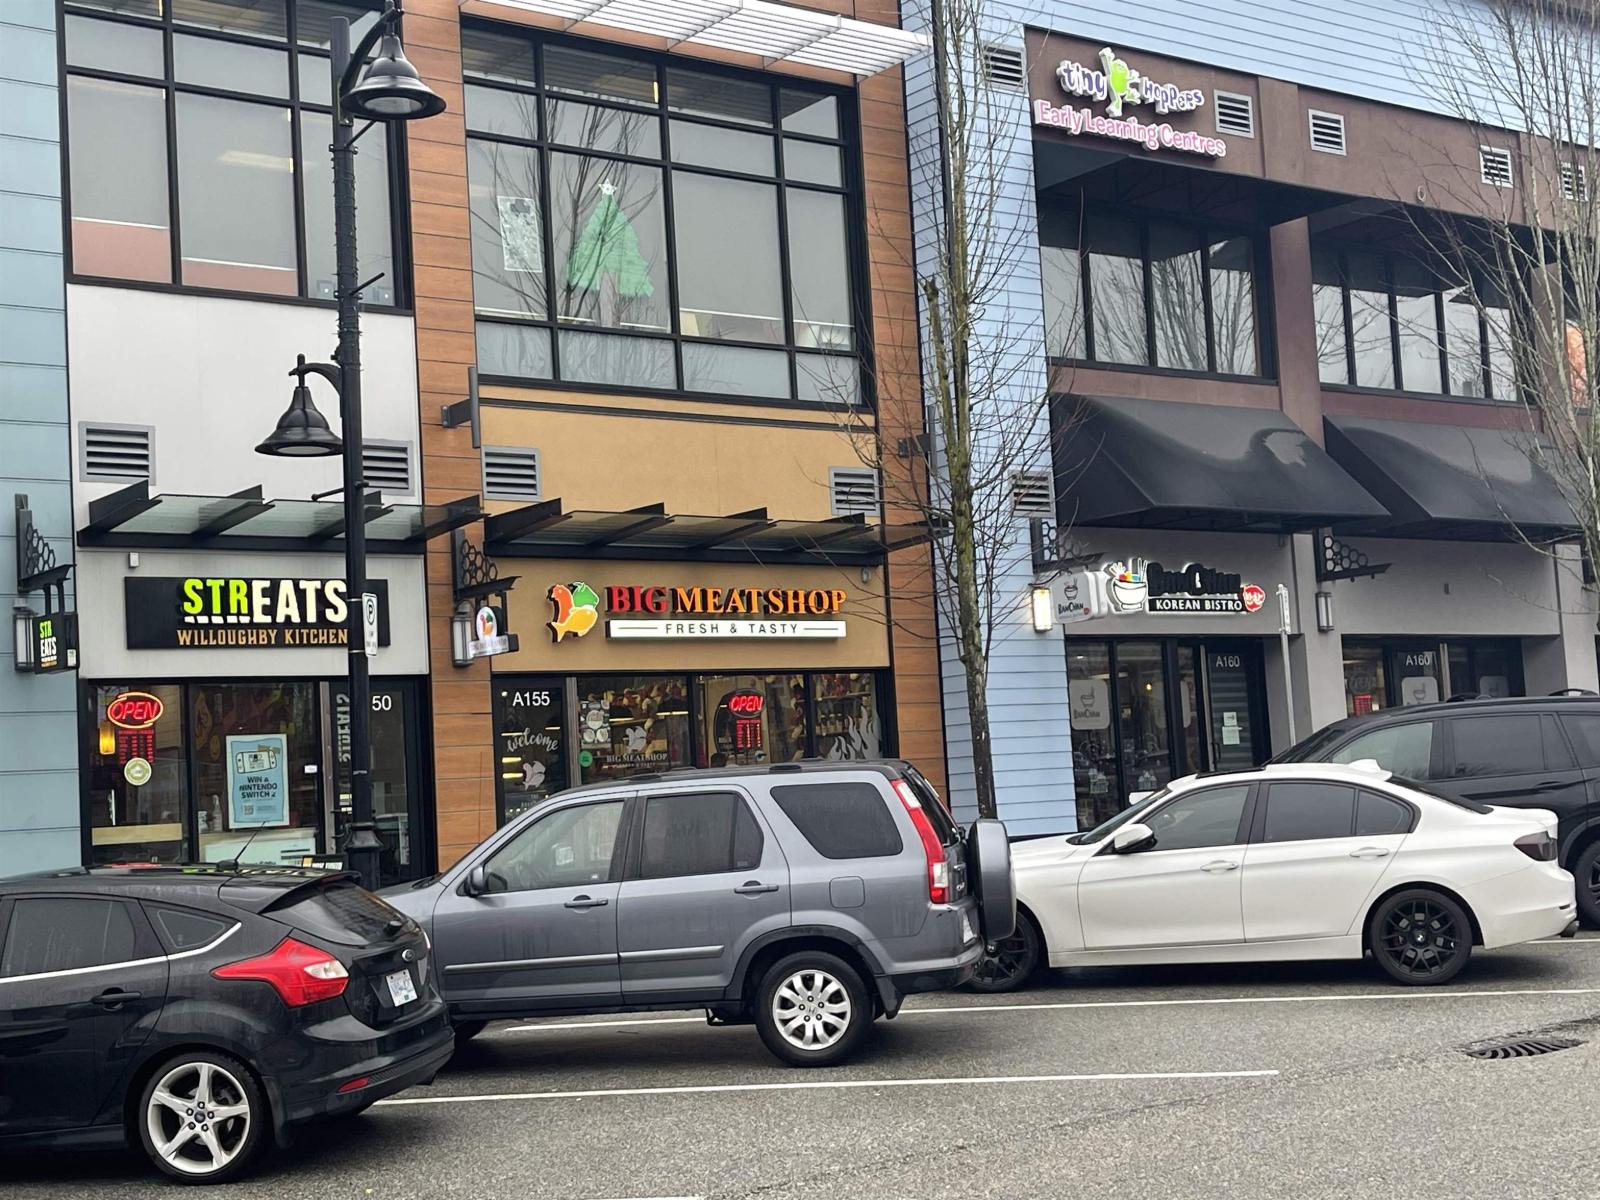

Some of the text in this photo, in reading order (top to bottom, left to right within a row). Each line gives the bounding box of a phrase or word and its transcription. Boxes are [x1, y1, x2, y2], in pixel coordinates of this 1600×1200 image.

[1061, 62, 1107, 99] tiny
[1036, 100, 1226, 157] Early Learning Centres
[183, 578, 348, 624] STREATS
[610, 585, 668, 614] BIG
[1156, 599, 1243, 610] KOREAN BISTRO
[176, 629, 278, 646] WILLOUGHBY
[284, 628, 348, 645] KITCHEN
[665, 622, 798, 634] FRESH & TASTY
[40, 636, 57, 658] EATS
[1215, 655, 1240, 668] A160
[1405, 654, 1432, 667] A160
[511, 690, 551, 707] A155
[730, 694, 765, 713] OPEN
[110, 700, 160, 721] OPEN
[505, 726, 560, 753] welcome
[239, 783, 278, 791] NINTENDO
